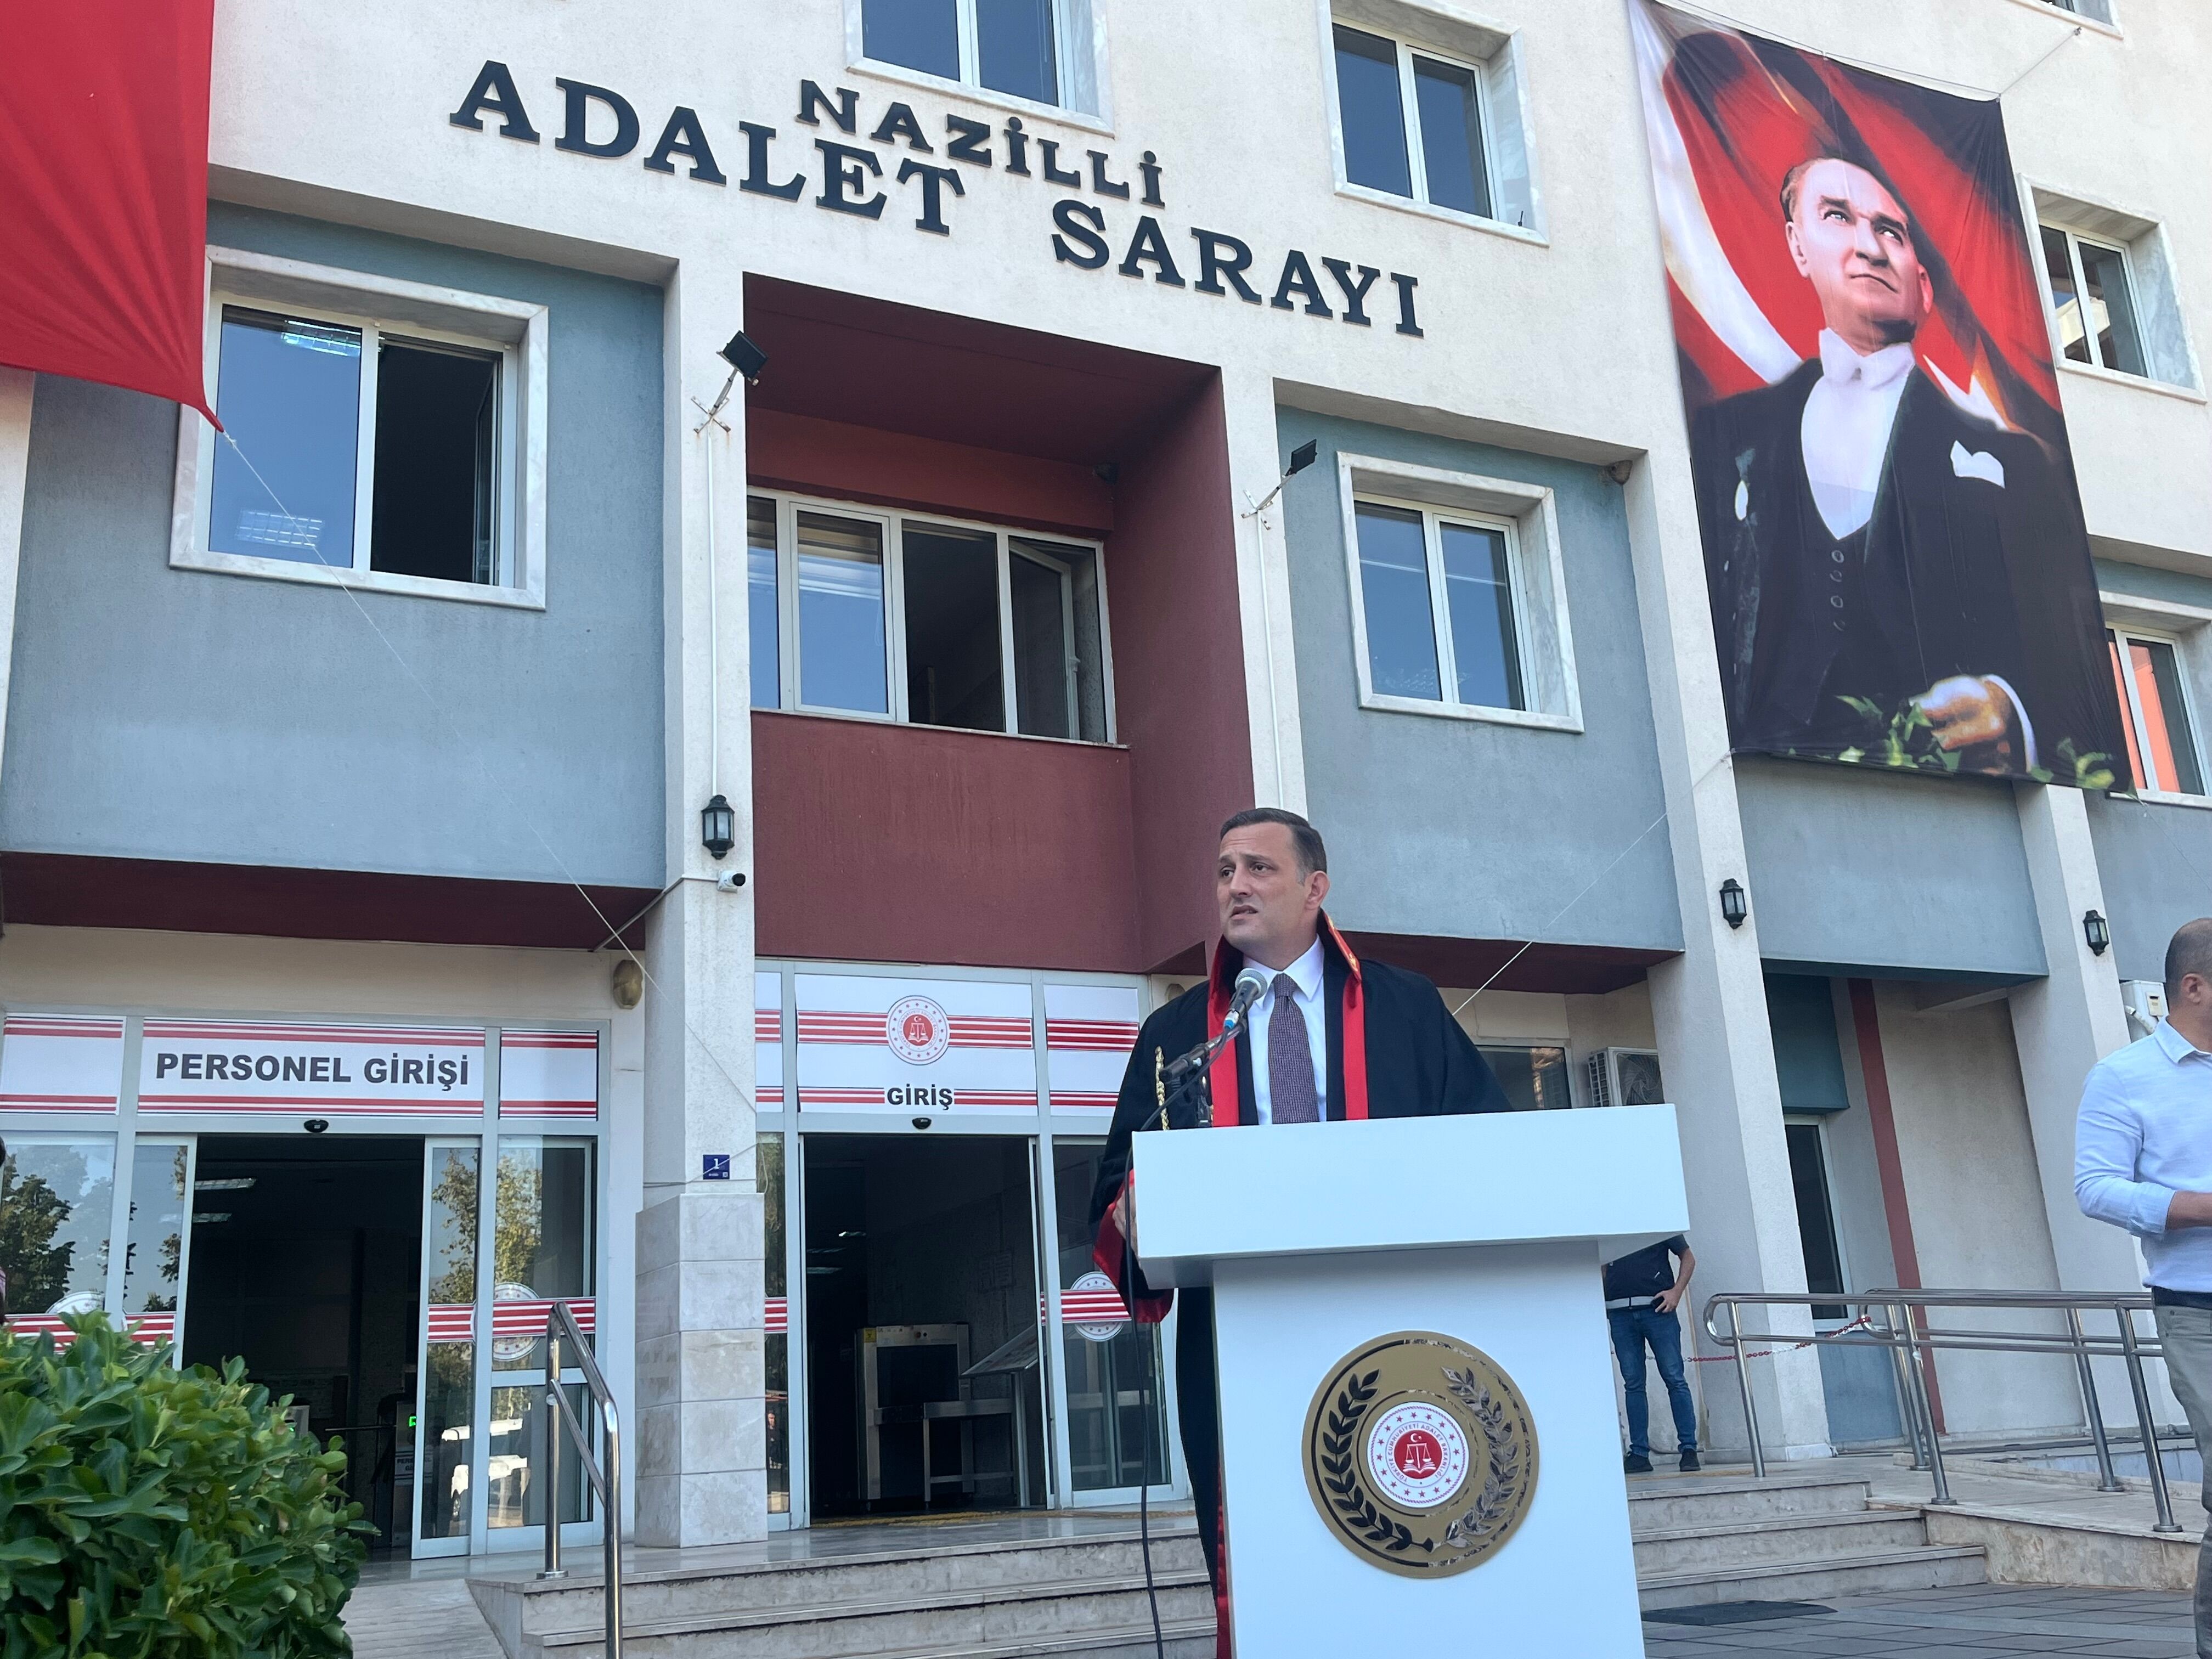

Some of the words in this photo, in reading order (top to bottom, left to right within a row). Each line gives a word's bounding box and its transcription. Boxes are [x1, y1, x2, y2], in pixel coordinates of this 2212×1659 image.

[797, 79, 1166, 207] NAZİLLİ
[449, 60, 966, 235] ADALET
[1051, 199, 1424, 337] SARAYI
[156, 1053, 351, 1082] PERSONEL
[364, 1053, 469, 1092] GİRİŞİ
[887, 1083, 953, 1111] GİRİŞ
[714, 1158, 720, 1169] 1
